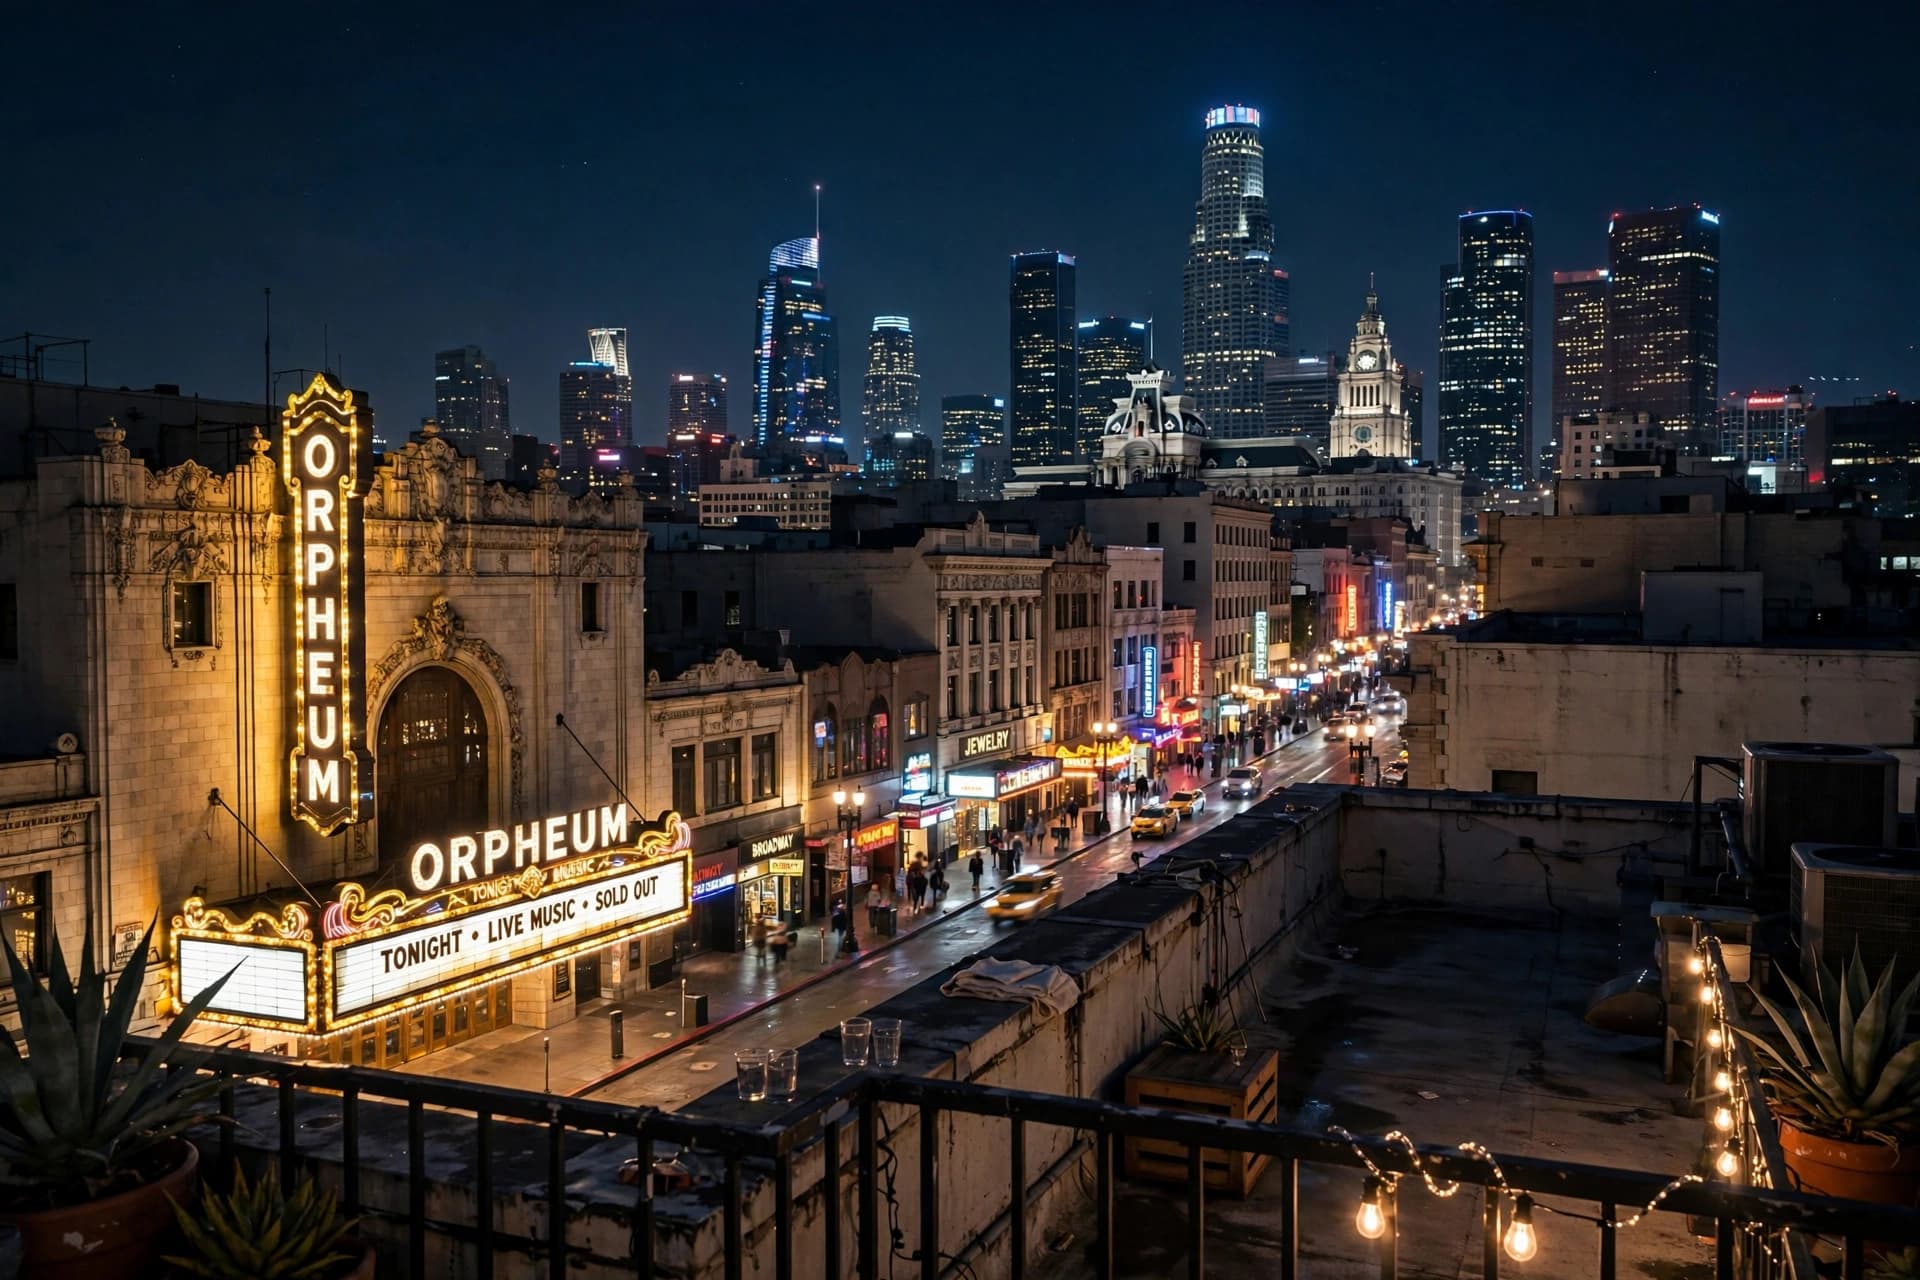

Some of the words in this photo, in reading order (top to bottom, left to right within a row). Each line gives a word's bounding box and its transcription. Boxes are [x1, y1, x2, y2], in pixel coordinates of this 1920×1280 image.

[303, 433, 340, 804] ORPHEUM
[964, 729, 1010, 757] JEWELRY
[410, 803, 628, 892] ORPHEUM
[752, 833, 794, 858] BROADWAY
[380, 929, 464, 974] TONIGHT
[487, 913, 525, 944] LIVE
[530, 898, 576, 931] MUSIC
[595, 884, 629, 912] SOLD
[633, 875, 659, 899] OUT
